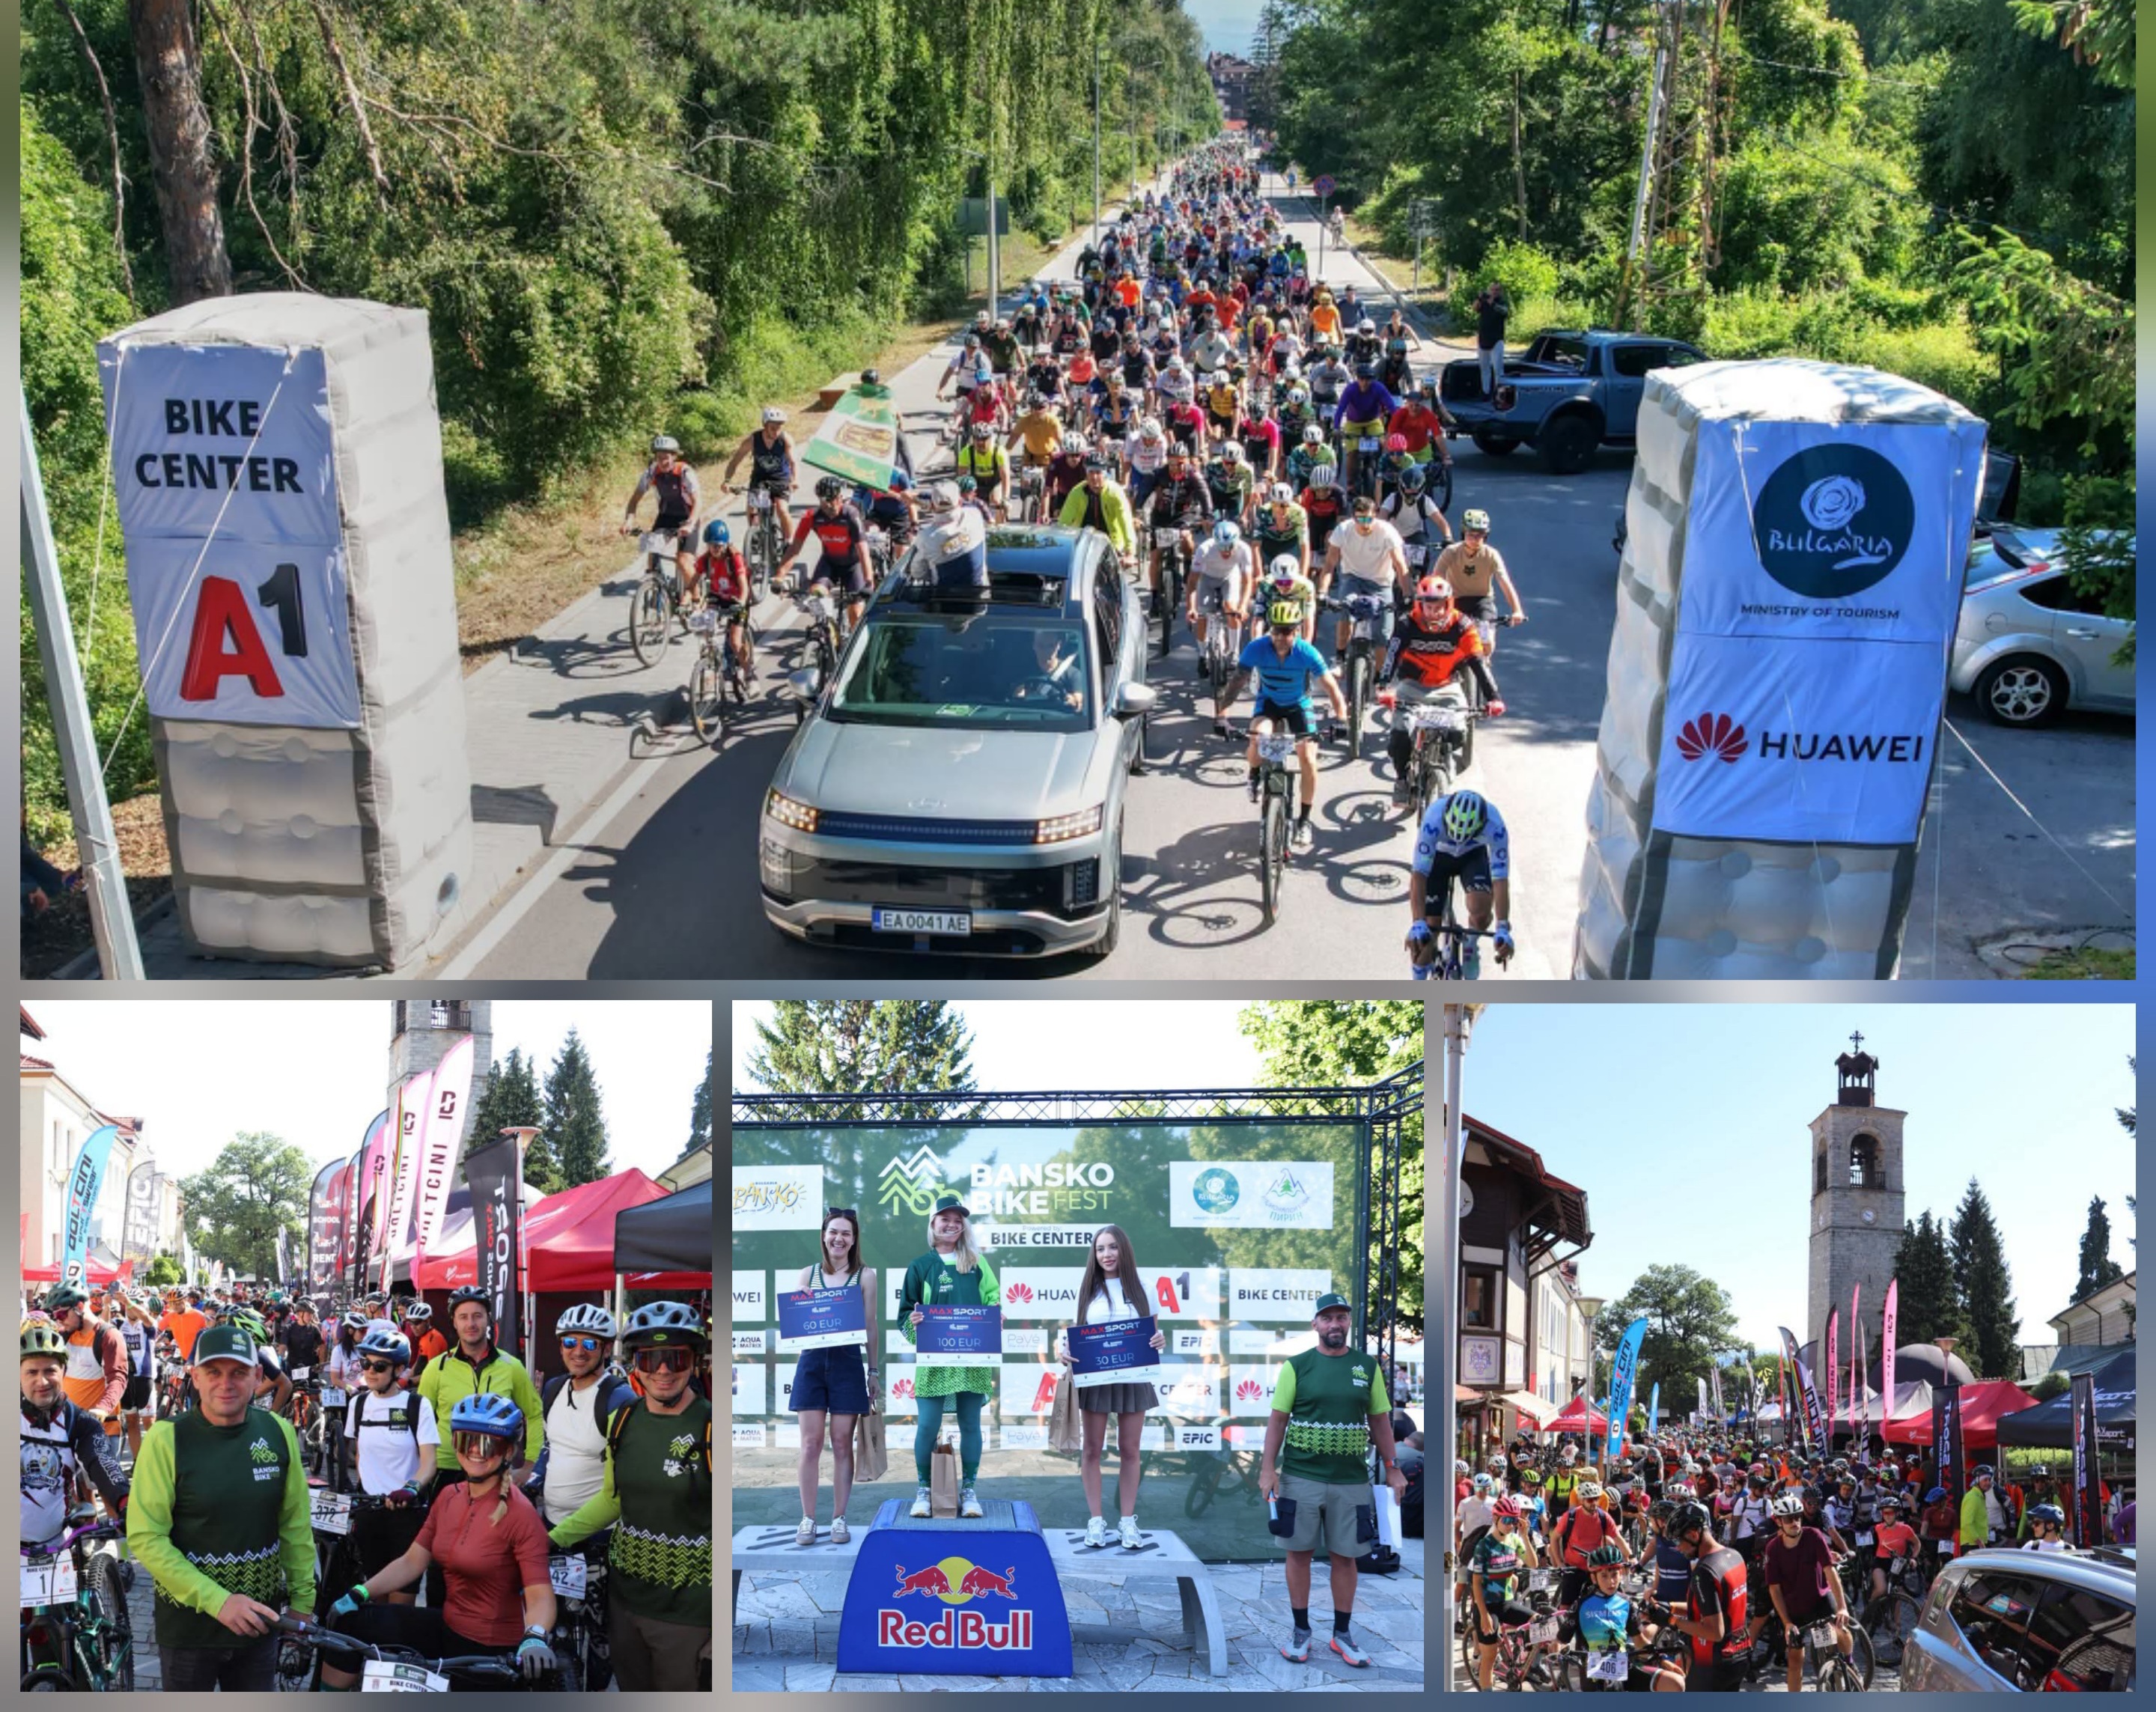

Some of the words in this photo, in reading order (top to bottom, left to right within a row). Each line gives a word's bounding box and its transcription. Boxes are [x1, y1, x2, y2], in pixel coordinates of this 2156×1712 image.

[164, 399, 261, 437] BIKE
[135, 453, 304, 494] CENTER
[1740, 603, 1808, 617] MINISTRY
[1812, 607, 1834, 617] OF
[1836, 608, 1900, 620] TOURISM
[180, 563, 308, 702] A1
[1760, 731, 1922, 763] HUAWEI
[885, 913, 903, 928] EA
[907, 914, 943, 930] 0041
[947, 917, 965, 933] AE
[970, 1163, 1115, 1187] BANSKO
[969, 1190, 1050, 1216] BIKE
[1054, 1190, 1113, 1210] FEST
[312, 1216, 341, 1224] SCHOOL
[991, 1232, 1027, 1246] BIKE
[1032, 1232, 1093, 1246] CENTER
[312, 1253, 336, 1263] RENT
[732, 1292, 761, 1303] WEI
[791, 1289, 848, 1301] MAXSPORT
[1238, 1289, 1268, 1300] BIKE
[803, 1320, 817, 1330] 60
[820, 1318, 842, 1329] EUR
[1080, 1321, 1140, 1335] MAXSPORT
[937, 1337, 956, 1347] 100
[958, 1337, 981, 1347] EUR
[1094, 1356, 1109, 1365] 30
[1111, 1353, 1135, 1363] EUR
[1032, 1372, 1058, 1412] A
[252, 1466, 281, 1475] BANSKO
[315, 1505, 336, 1524] 372
[40, 1573, 46, 1594] 1
[879, 1609, 954, 1648] Red
[957, 1610, 1033, 1651] Bull
[1600, 1660, 1616, 1674] 406
